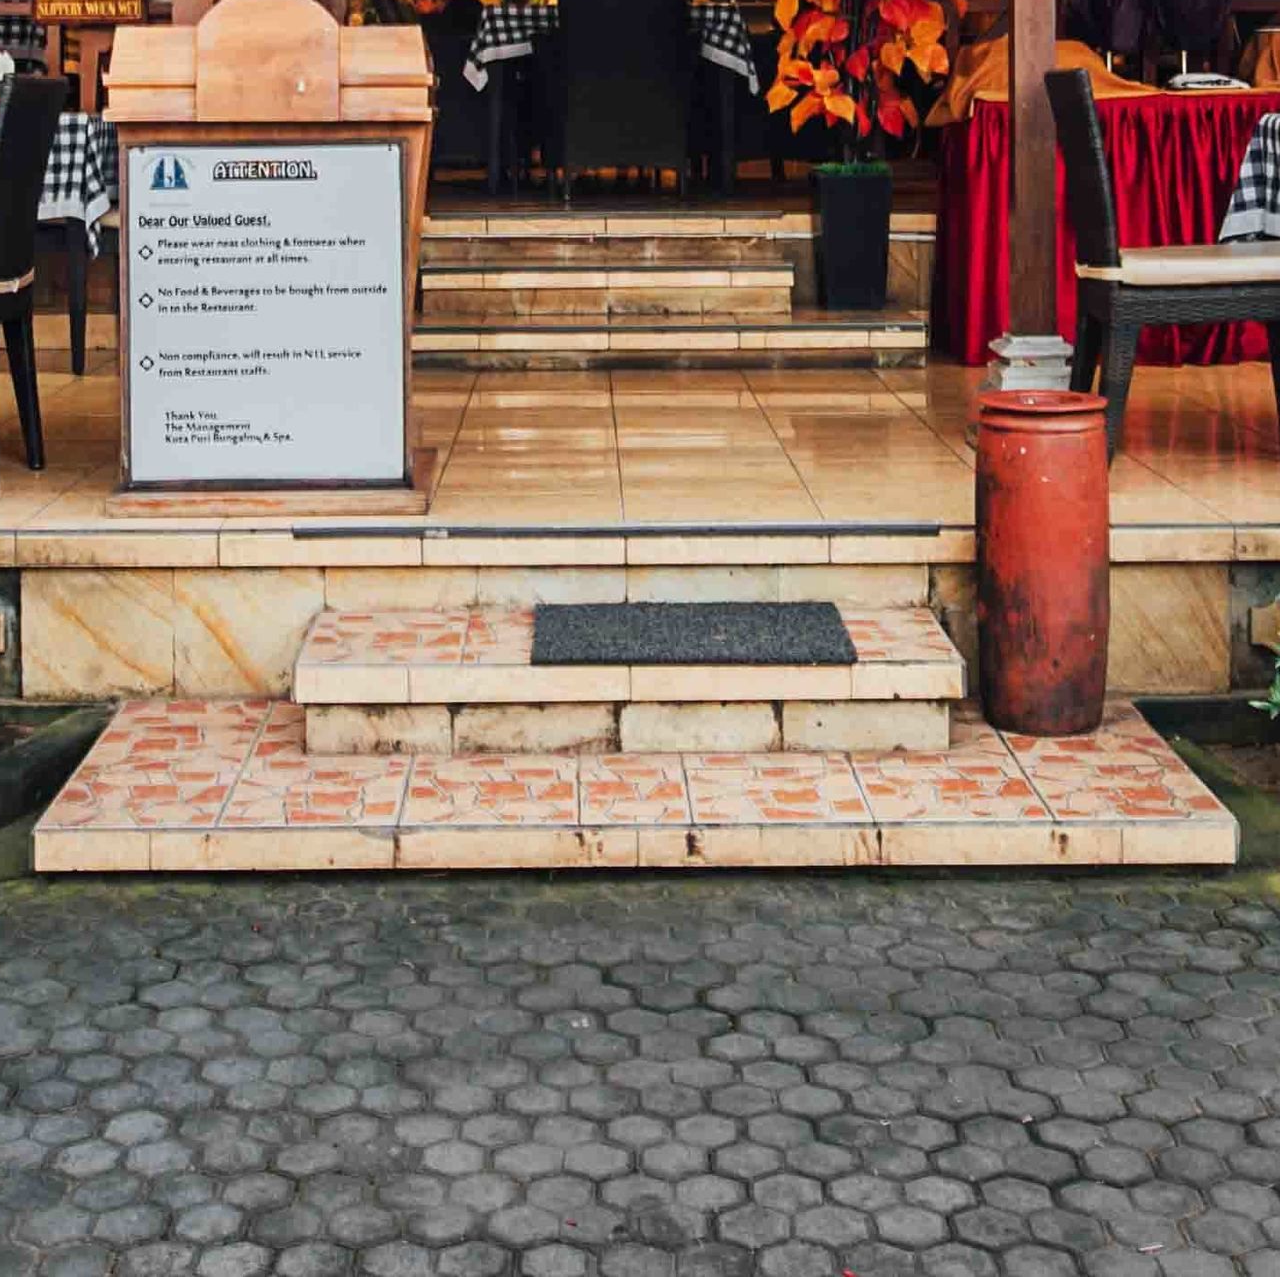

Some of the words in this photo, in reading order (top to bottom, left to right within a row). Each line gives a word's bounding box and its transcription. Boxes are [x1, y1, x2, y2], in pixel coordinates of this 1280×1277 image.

[38, 2, 81, 16] SLIPPERY
[118, 1, 139, 15] WET
[138, 215, 164, 227] Dear
[168, 215, 188, 227] Our
[192, 213, 231, 226] Valued
[158, 238, 188, 248] Please
[191, 239, 214, 248] wear
[217, 238, 239, 248] neat
[241, 236, 281, 250] clothing
[283, 237, 291, 247] &
[293, 236, 336, 247] footwear
[338, 235, 366, 246] when
[158, 255, 199, 267] entering
[201, 254, 252, 265] restaurant
[255, 255, 264, 264] at
[267, 252, 279, 264] all
[158, 286, 173, 297] No
[175, 284, 199, 297] Food
[201, 286, 209, 296] &
[211, 285, 260, 299] Beverages
[262, 286, 273, 296] to
[275, 283, 286, 296] be
[289, 283, 324, 299] bought
[326, 282, 349, 295] from
[351, 283, 388, 295] outside
[170, 303, 181, 313] to
[183, 302, 199, 313] the
[159, 350, 180, 361] Non
[242, 349, 260, 360] will
[263, 348, 290, 360] result
[293, 349, 302, 359] in
[327, 351, 362, 359] service
[159, 367, 183, 378] from
[185, 366, 238, 378] Restaurant
[165, 410, 195, 421] Thank
[165, 422, 183, 432] The
[186, 422, 251, 433] Management
[165, 433, 189, 443] Kuta
[263, 432, 271, 441] &
